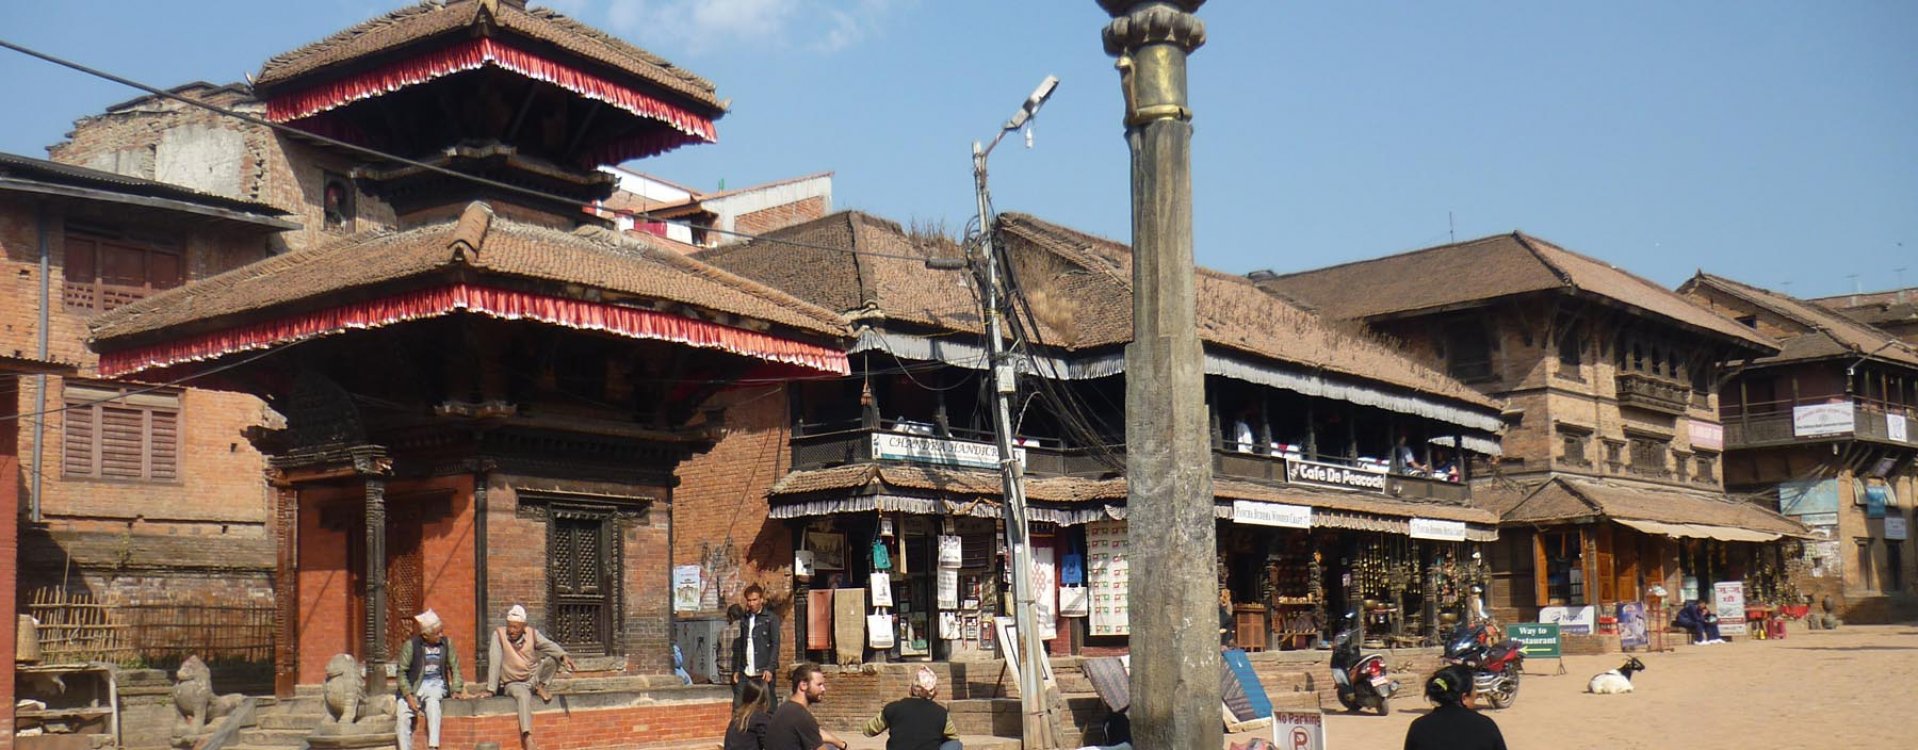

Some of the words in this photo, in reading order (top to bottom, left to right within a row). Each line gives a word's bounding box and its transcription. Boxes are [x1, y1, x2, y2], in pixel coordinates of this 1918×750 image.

[1300, 464, 1326, 481] Cafe
[1327, 468, 1341, 483] De
[1343, 470, 1384, 488] Peacock
[1519, 627, 1536, 636] Way
[1275, 711, 1287, 724] No
[1288, 712, 1321, 727] Parking
